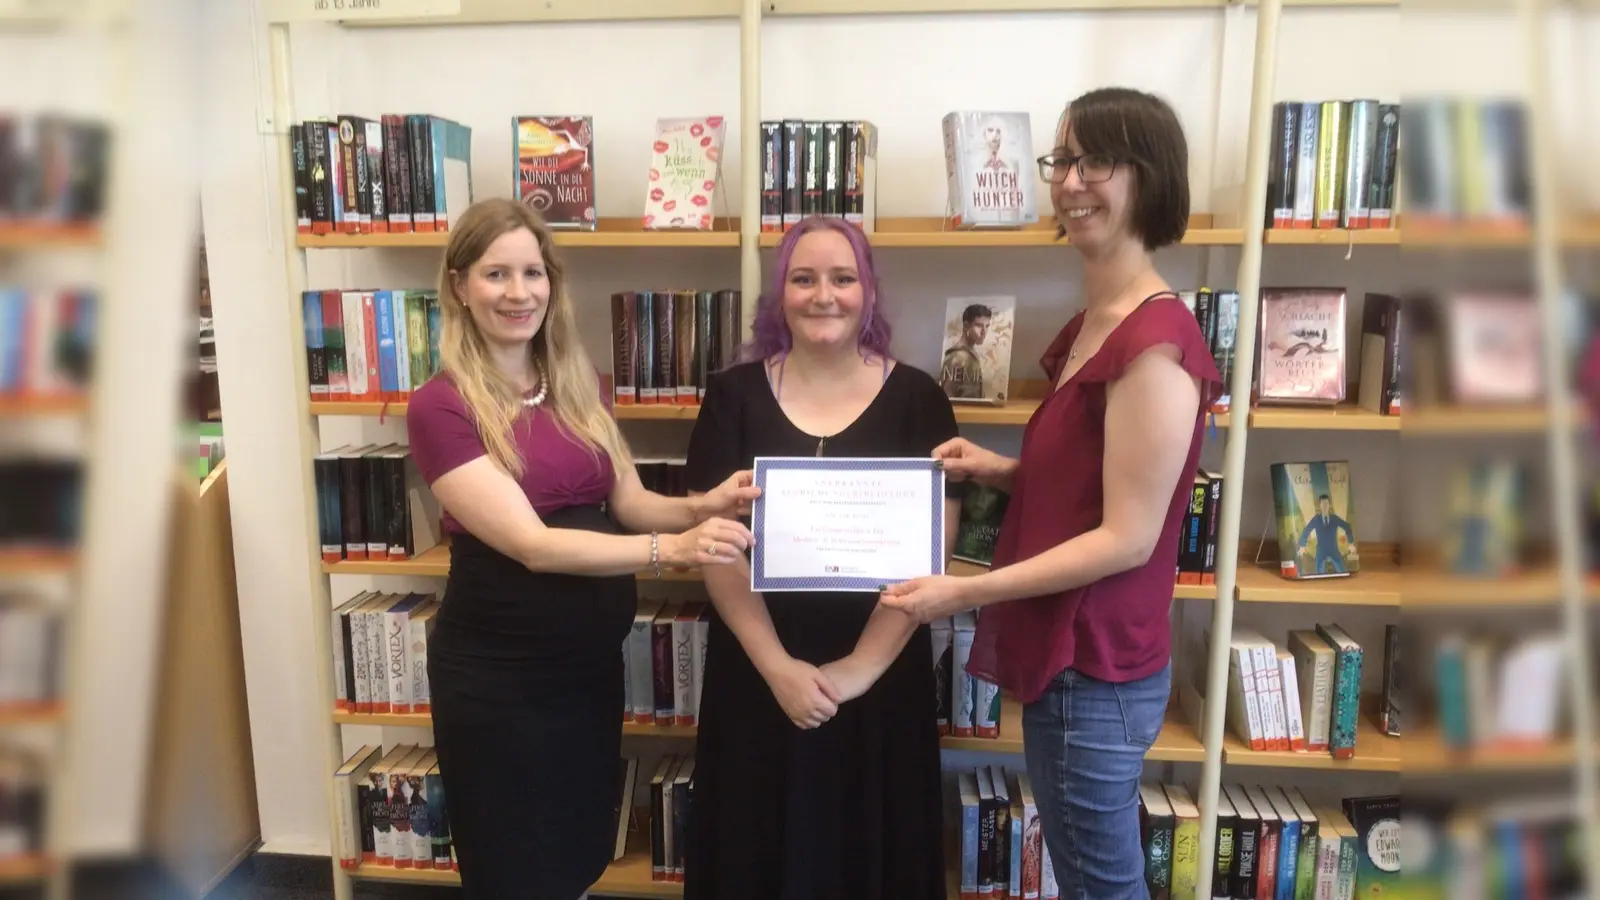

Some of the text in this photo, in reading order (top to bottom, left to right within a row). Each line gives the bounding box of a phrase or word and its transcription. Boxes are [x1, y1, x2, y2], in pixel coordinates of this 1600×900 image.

[523, 170, 557, 185] SONNE
[560, 173, 569, 184] IN
[676, 167, 706, 178] wenn
[976, 172, 1017, 188] WITCH
[557, 185, 588, 203] NACHT
[973, 192, 1024, 207] HUNTER
[389, 626, 403, 680] VORTEX
[678, 634, 690, 690] VORTEX
[1150, 829, 1164, 867] MOON
[1177, 834, 1189, 863] SUN
[1220, 828, 1233, 856] ORDER
[1239, 830, 1255, 877] PHASE NULL
[1376, 840, 1400, 851] EDWAR
